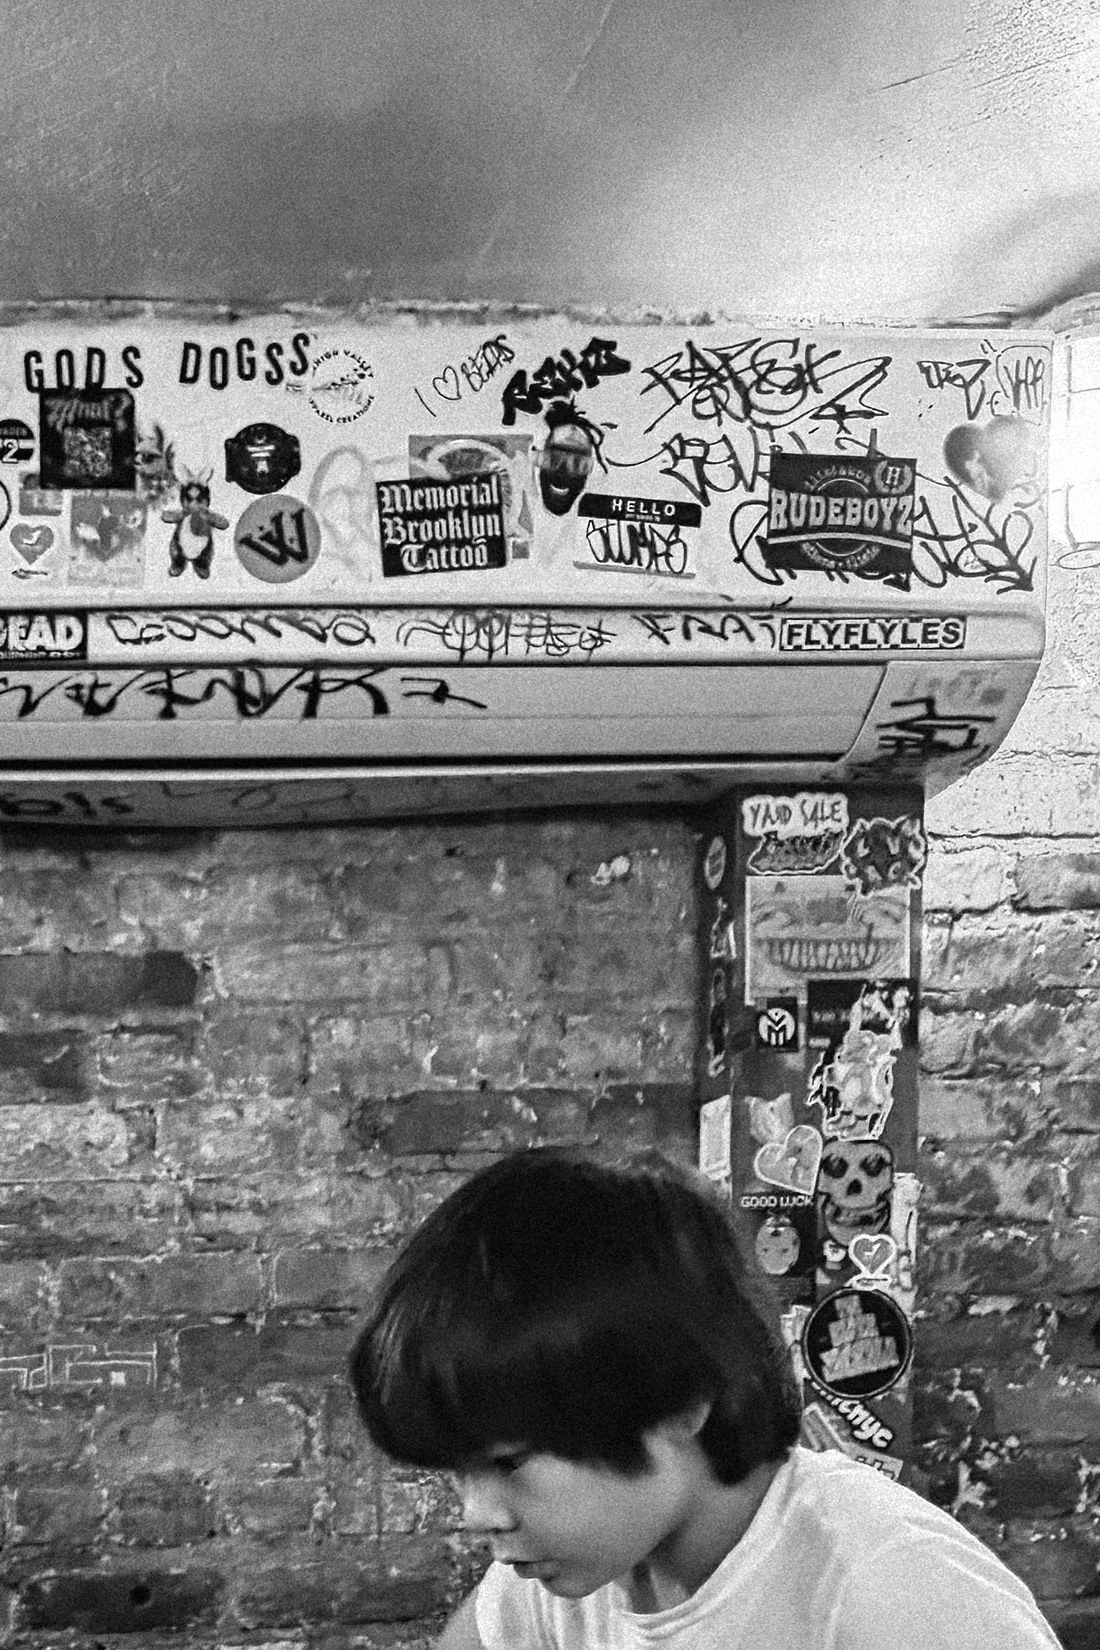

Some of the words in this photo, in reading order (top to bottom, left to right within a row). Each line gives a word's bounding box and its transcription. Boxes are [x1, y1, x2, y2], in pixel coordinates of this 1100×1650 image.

[24, 346, 144, 393] GODS
[380, 474, 500, 514] Memorial
[612, 499, 676, 516] HELLO
[770, 488, 915, 536] RUDEBOYZ
[382, 510, 501, 546] Brooklyn
[400, 543, 488, 572] Tattoo
[787, 620, 961, 646] FLYFLYLES
[800, 797, 844, 826] SALE
[741, 1195, 778, 1208] GOOD
